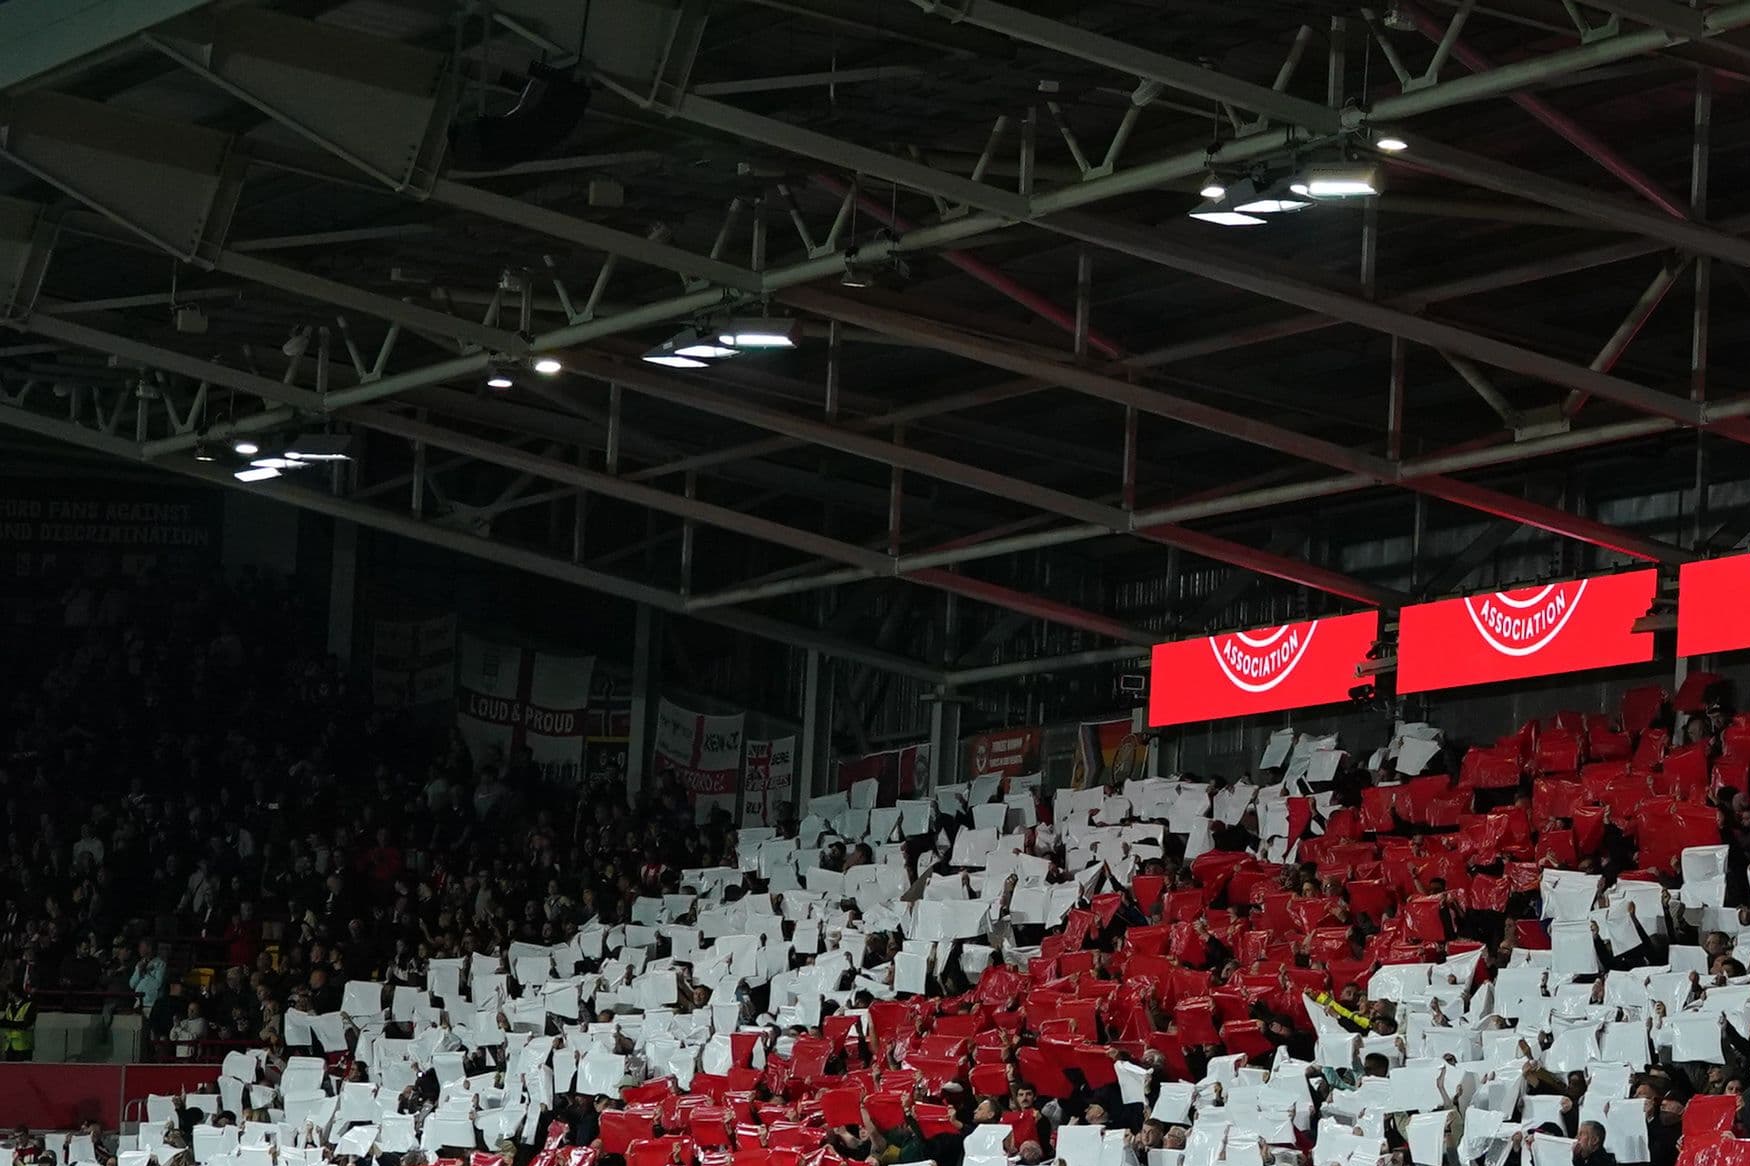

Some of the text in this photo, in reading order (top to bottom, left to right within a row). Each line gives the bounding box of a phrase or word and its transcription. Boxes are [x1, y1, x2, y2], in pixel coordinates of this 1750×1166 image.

[1481, 589, 1566, 640] ASSOCIATION
[1223, 630, 1298, 677] ASSOCIATION
[470, 694, 575, 734] LOUD & PROUD
